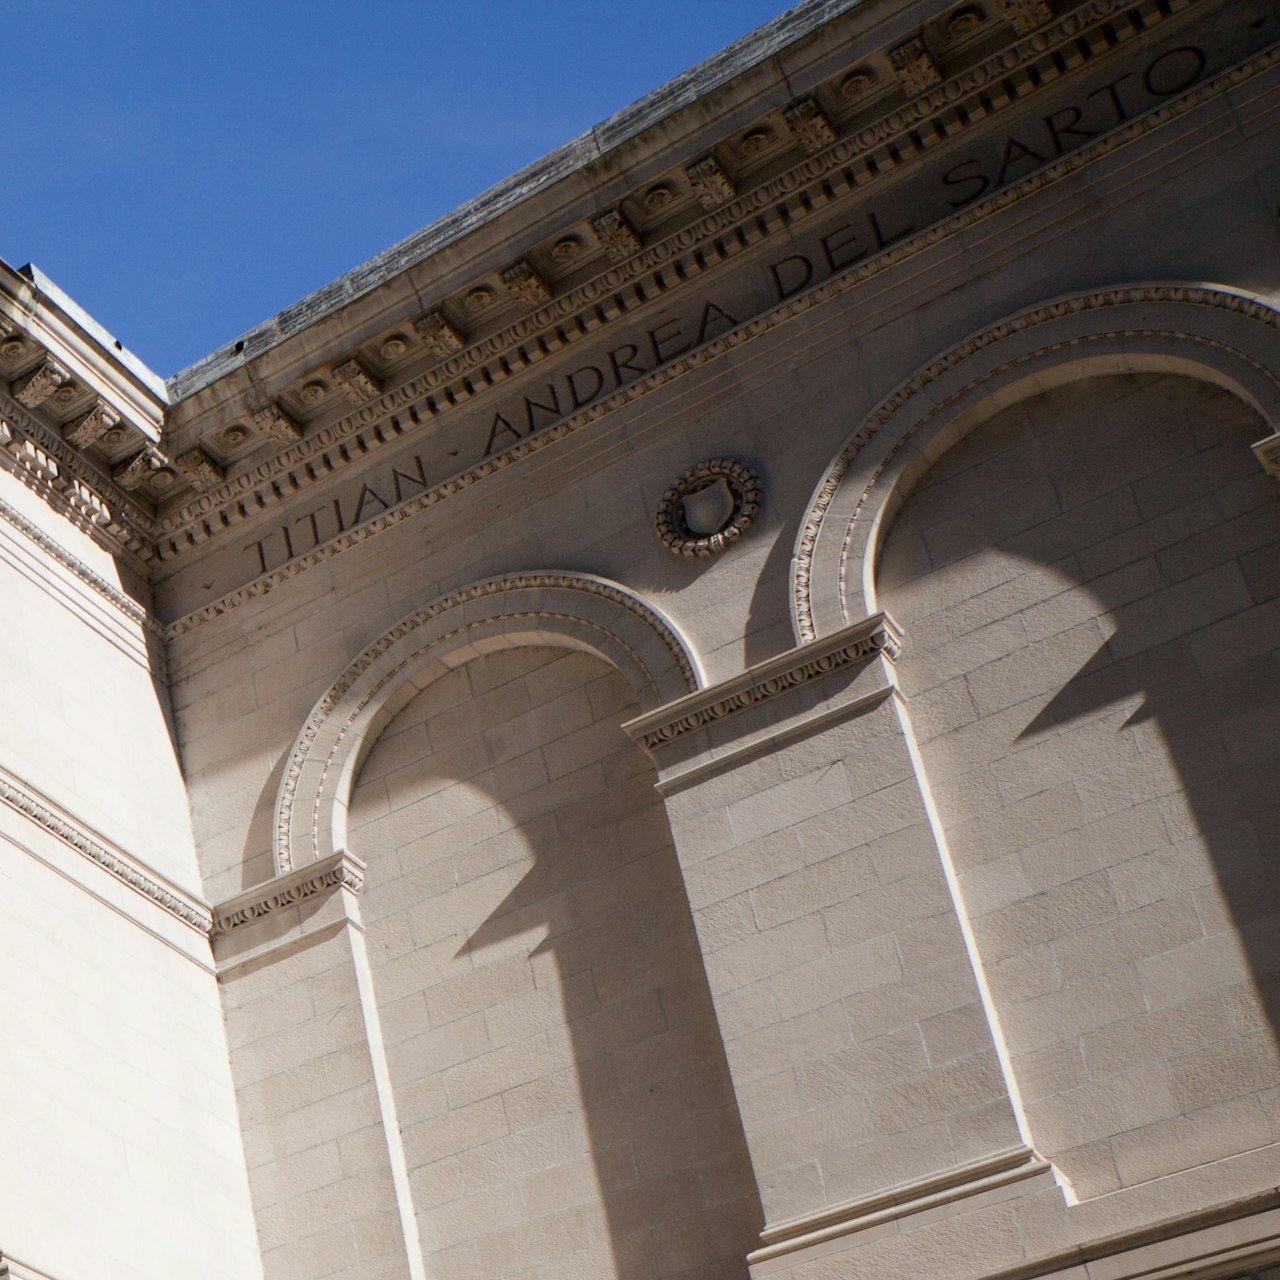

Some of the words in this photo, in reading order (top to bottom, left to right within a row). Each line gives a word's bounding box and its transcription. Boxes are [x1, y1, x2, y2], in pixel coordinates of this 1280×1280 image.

[242, 455, 427, 573] TITIAN
[484, 299, 740, 456] ANDREA
[768, 211, 914, 301] DEL
[942, 45, 1207, 209] SARTO
